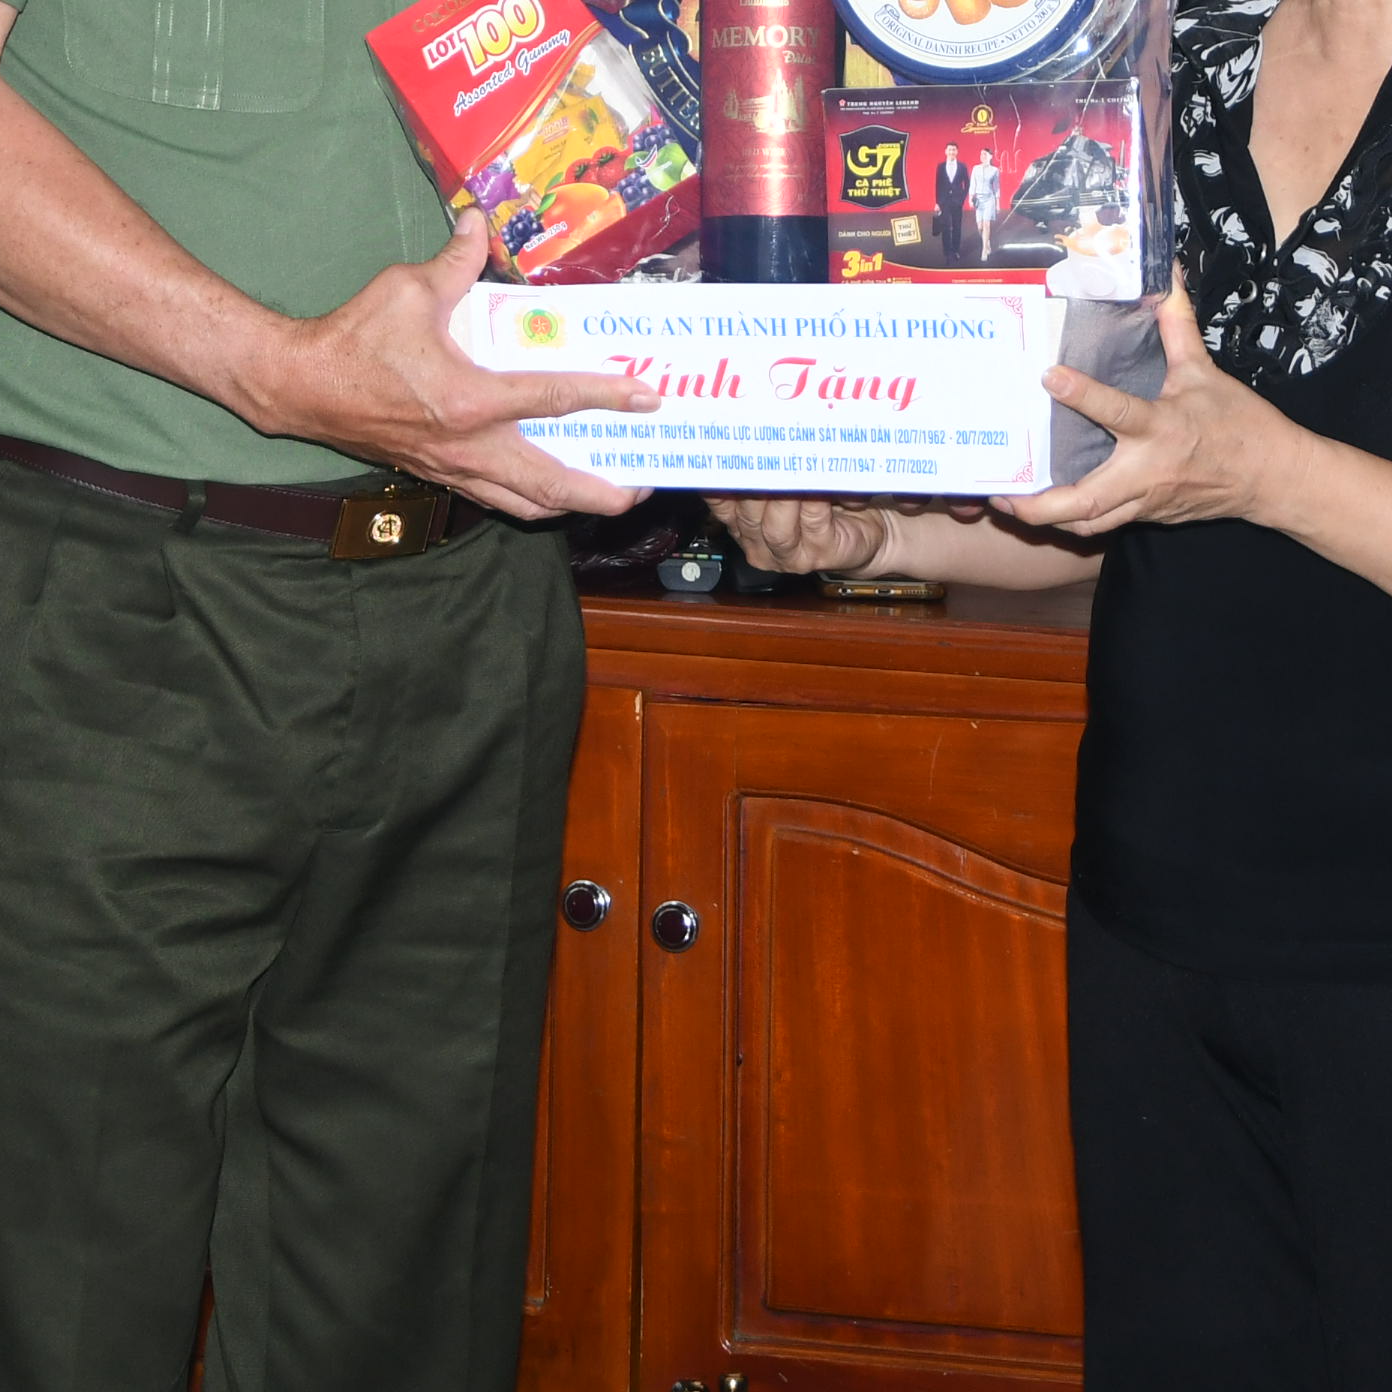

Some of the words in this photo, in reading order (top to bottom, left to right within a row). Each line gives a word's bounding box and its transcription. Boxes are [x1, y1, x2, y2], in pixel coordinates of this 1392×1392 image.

[426, 32, 460, 65] LOT
[711, 24, 820, 49] MEMORY
[880, 15, 925, 49] ORIGINAL
[925, 42, 963, 54] DANISH
[964, 40, 1001, 55] RECIPE
[1005, 20, 1037, 44] NETTO
[455, 62, 514, 115] Assorted
[516, 30, 570, 74] Gummy
[841, 250, 883, 278] 3in1
[583, 310, 652, 336] CÔNG
[661, 316, 693, 336] AN
[700, 311, 787, 337] THÀNH
[796, 308, 847, 338] PHỐ
[855, 311, 899, 338] HẢI
[907, 313, 995, 339] PHÒNG
[601, 354, 746, 399] Kính
[769, 356, 922, 411] Tặng
[519, 420, 546, 437] NHÂN
[563, 420, 588, 441] NIỆM
[591, 424, 603, 438] 60
[606, 421, 628, 439] NĂM
[631, 422, 656, 439] NGÀY
[659, 420, 696, 440] TRUYỀN
[699, 420, 730, 440] THỐNG
[733, 425, 752, 443] LỰC
[754, 425, 786, 444] LƯỢNG
[788, 421, 816, 442] CẢNH
[819, 424, 837, 442] SÁT
[840, 424, 867, 443] NHÂN
[871, 424, 891, 443] DÂN
[894, 428, 946, 446] (20/7/1962
[955, 430, 1009, 447] 20/7/2022)
[589, 452, 602, 467] VÀ
[620, 452, 645, 471] NIỆM
[648, 454, 659, 468] 75
[662, 452, 685, 469] NĂM
[688, 453, 712, 469] NGÀY
[717, 455, 754, 470] THƯƠNG
[757, 456, 780, 471] BINH
[783, 453, 802, 475] LIỆT
[828, 458, 875, 473] 27/7/1947
[886, 458, 937, 475] 27/7/2022)
